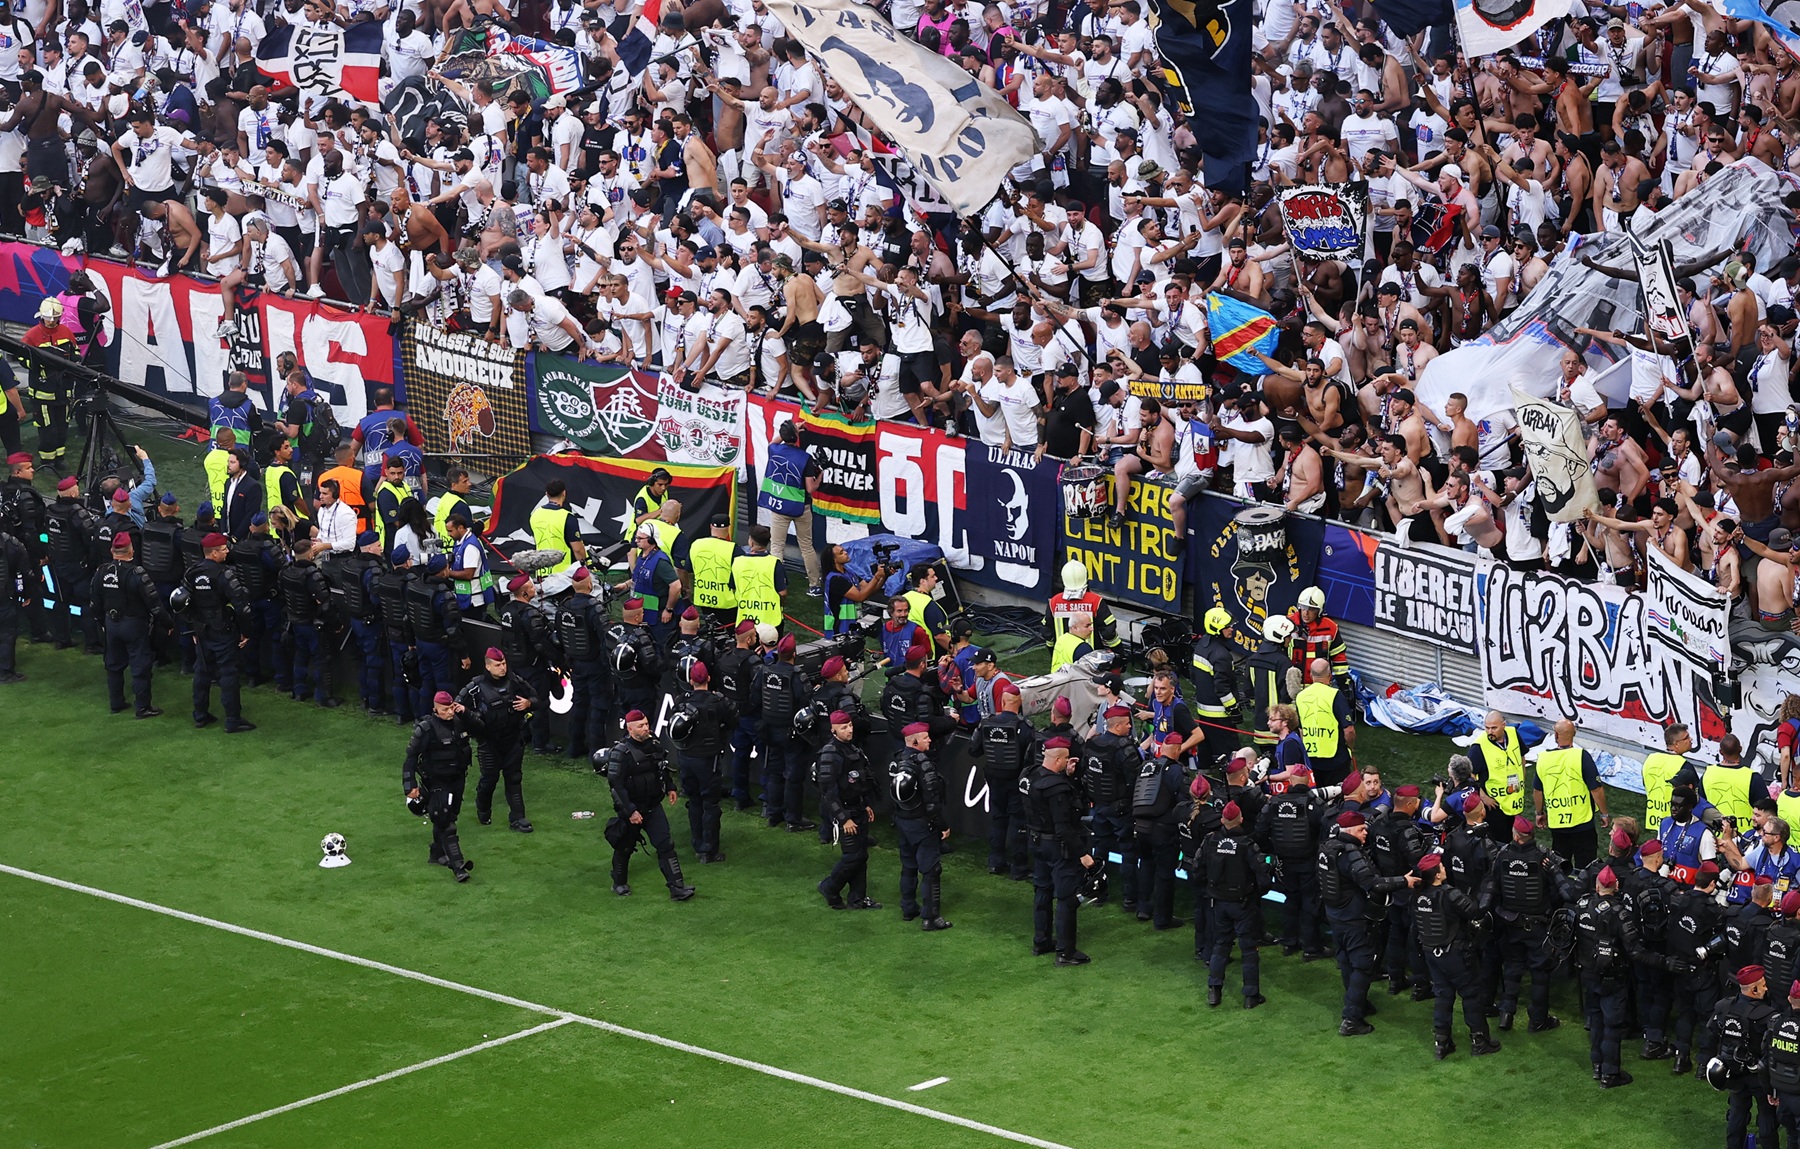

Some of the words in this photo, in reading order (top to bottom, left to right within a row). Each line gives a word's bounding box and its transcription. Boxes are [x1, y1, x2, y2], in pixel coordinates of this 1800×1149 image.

[415, 322, 431, 343] DU
[432, 327, 472, 353] PASSE
[471, 339, 488, 358] JE
[489, 343, 517, 363] SUIS
[416, 343, 514, 389] AMOUREUX
[1129, 381, 1162, 398] CENTRO
[1175, 384, 1206, 400] ANTICO
[1522, 407, 1560, 439] URBAN
[988, 446, 1037, 470] ULTRAS
[771, 483, 784, 495] TV
[768, 496, 783, 510] 073
[1375, 551, 1473, 614] LIBEREZ
[699, 593, 718, 605] 938
[1055, 603, 1068, 612] FIRE
[1069, 603, 1093, 612] SAFETY
[1375, 589, 1397, 622] LE
[1486, 562, 1702, 752] URBAN
[1559, 813, 1573, 825] 27
[1771, 1037, 1799, 1054] POLICE
